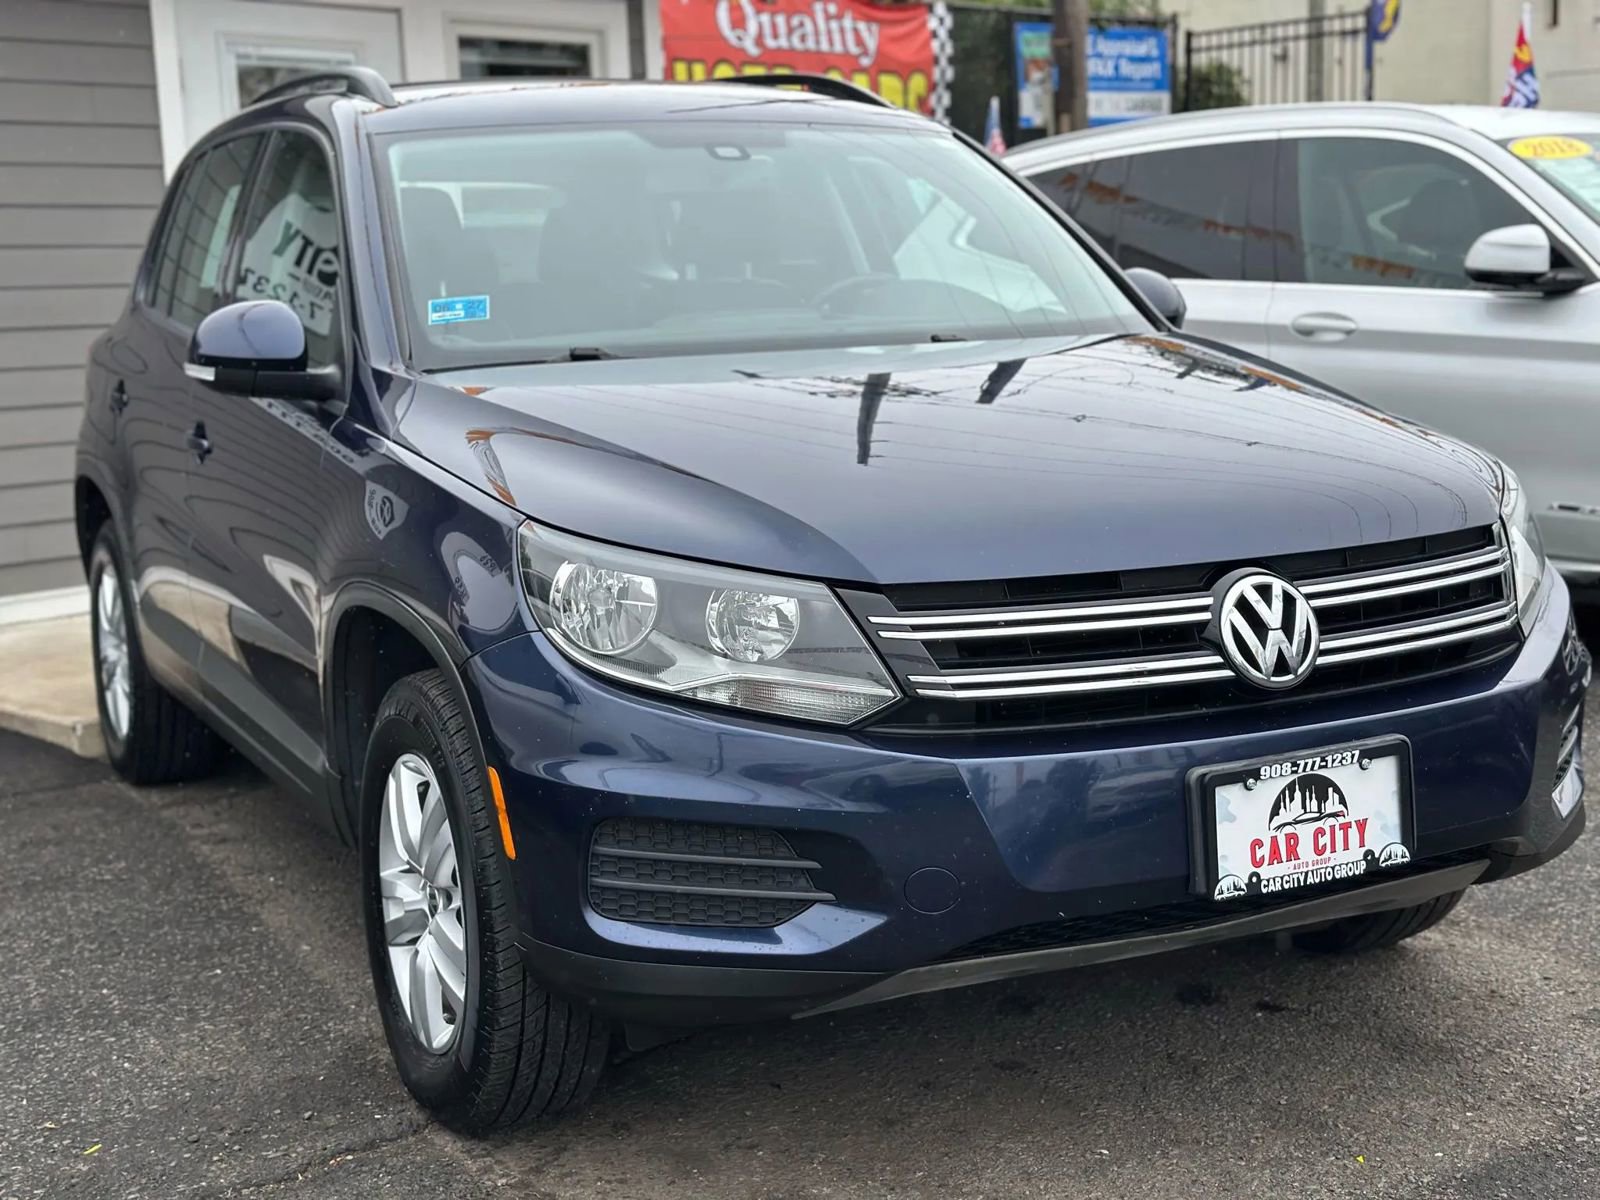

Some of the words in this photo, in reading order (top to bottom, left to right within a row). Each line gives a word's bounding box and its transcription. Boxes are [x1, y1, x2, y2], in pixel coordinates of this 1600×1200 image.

[715, 0, 881, 68] Quality
[1260, 750, 1360, 780] 908-777-1237
[1250, 832, 1300, 868] CAR
[1313, 818, 1368, 856] CITY
[1261, 877, 1282, 894] CAR
[1283, 872, 1306, 889] CITY
[1306, 867, 1333, 885] AUTO
[1334, 860, 1367, 879] GROUP
[1293, 861, 1309, 871] AUTO
[1312, 857, 1332, 867] GROUP
